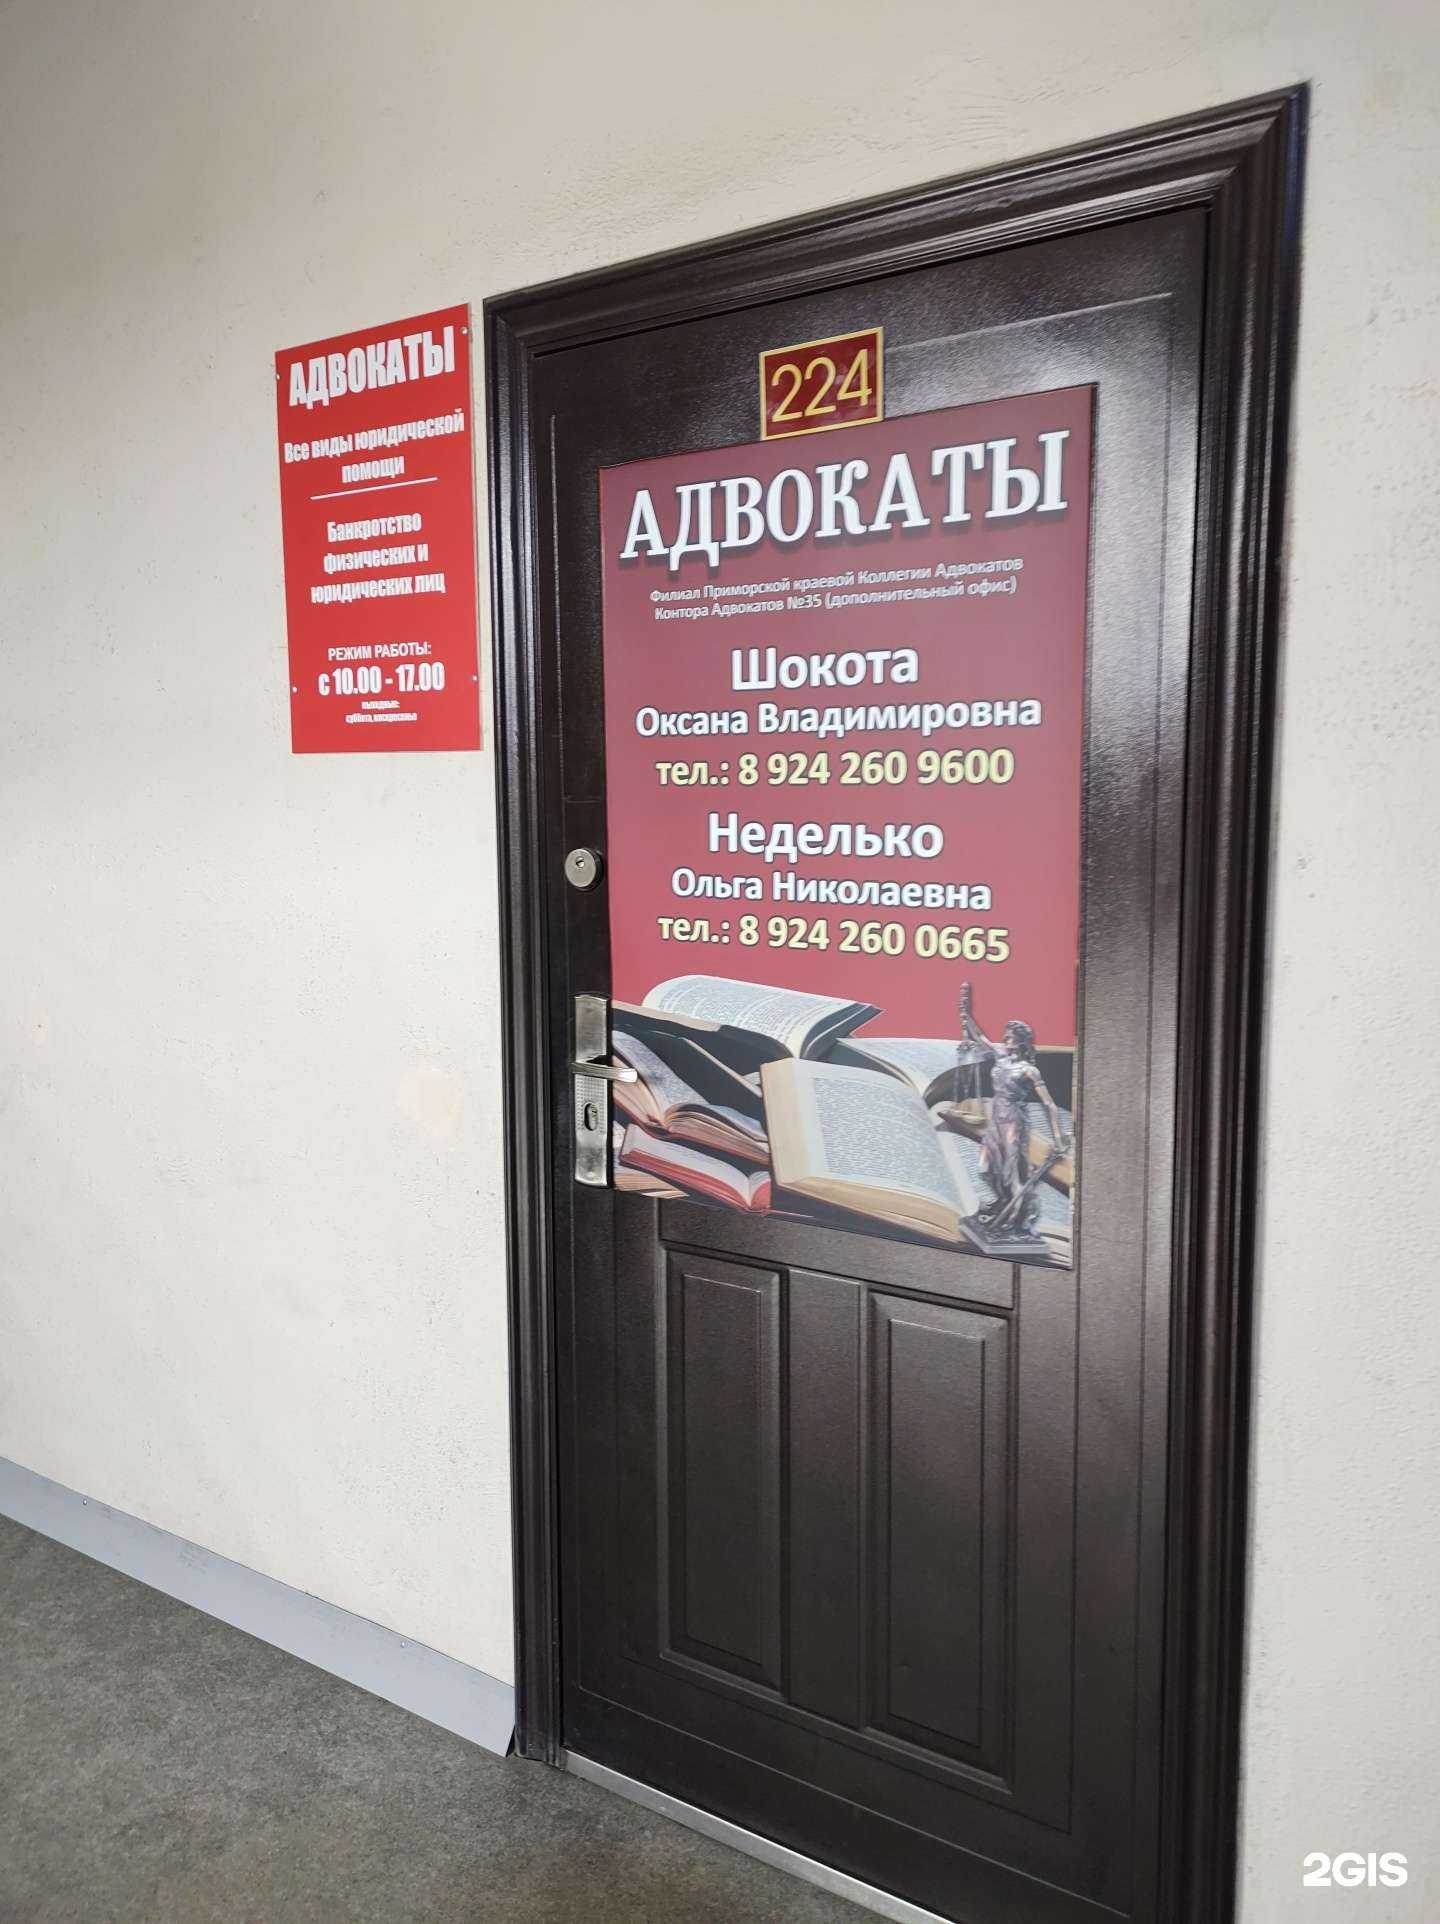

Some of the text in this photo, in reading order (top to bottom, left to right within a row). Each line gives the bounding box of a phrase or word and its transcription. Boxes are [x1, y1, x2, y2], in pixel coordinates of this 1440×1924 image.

[289, 325, 456, 410] АДВОКАТЫ
[771, 349, 872, 423] 224
[284, 408, 465, 463] Все виды юридической
[341, 455, 405, 483] помощи
[619, 429, 1070, 571] АДВОКАТЫ
[327, 513, 422, 543] Банкротство
[323, 544, 417, 574] физических
[650, 557, 1024, 602] Филиал Приморской краевой Коллегии Адвокатов
[311, 573, 446, 604] юридических лиц
[655, 575, 1018, 620] Контора Адвокатов №35 (дополнительный офис)
[328, 641, 432, 661] РЕЖИМ РАБОТЫ:
[731, 647, 919, 691] Шокота
[332, 665, 382, 695] 10.00
[395, 661, 445, 692] 17.00
[635, 699, 1042, 738] Оксана Владимировна
[656, 748, 1015, 785] тел.: 8 924 260 9600
[708, 812, 944, 863] Неделько
[671, 868, 992, 911] Ольга Николаевна
[657, 915, 1011, 963] тел.: 8 924 260 0665
